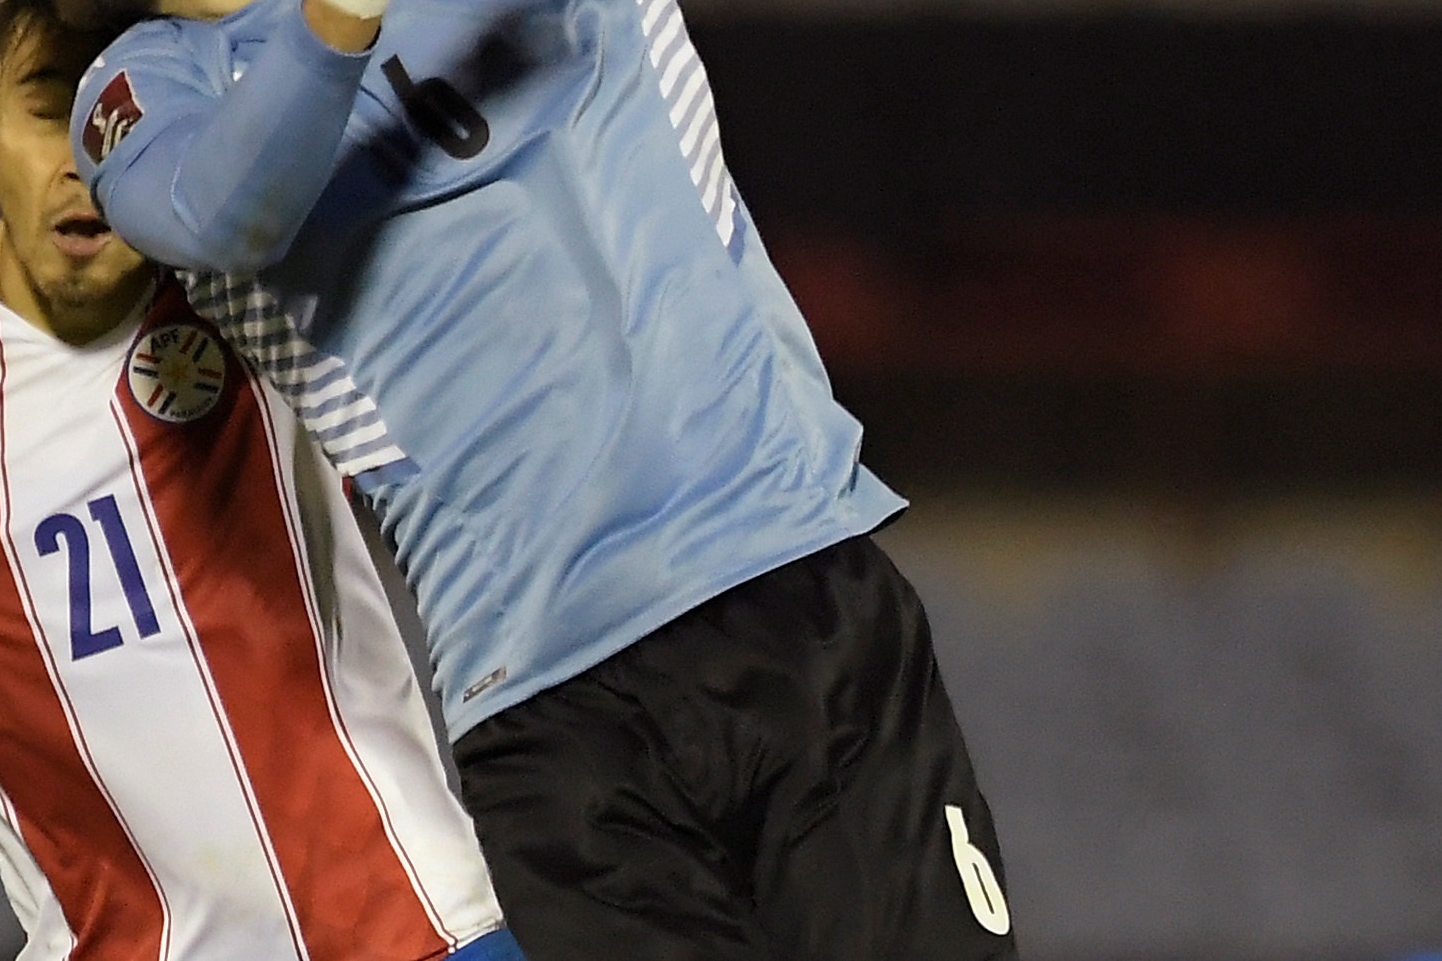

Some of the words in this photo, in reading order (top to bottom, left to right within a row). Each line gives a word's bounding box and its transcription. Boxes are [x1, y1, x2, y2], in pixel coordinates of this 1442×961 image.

[381, 54, 490, 160] 6
[150, 327, 179, 355] APF
[34, 494, 160, 661] 21
[945, 806, 1010, 935] 6
